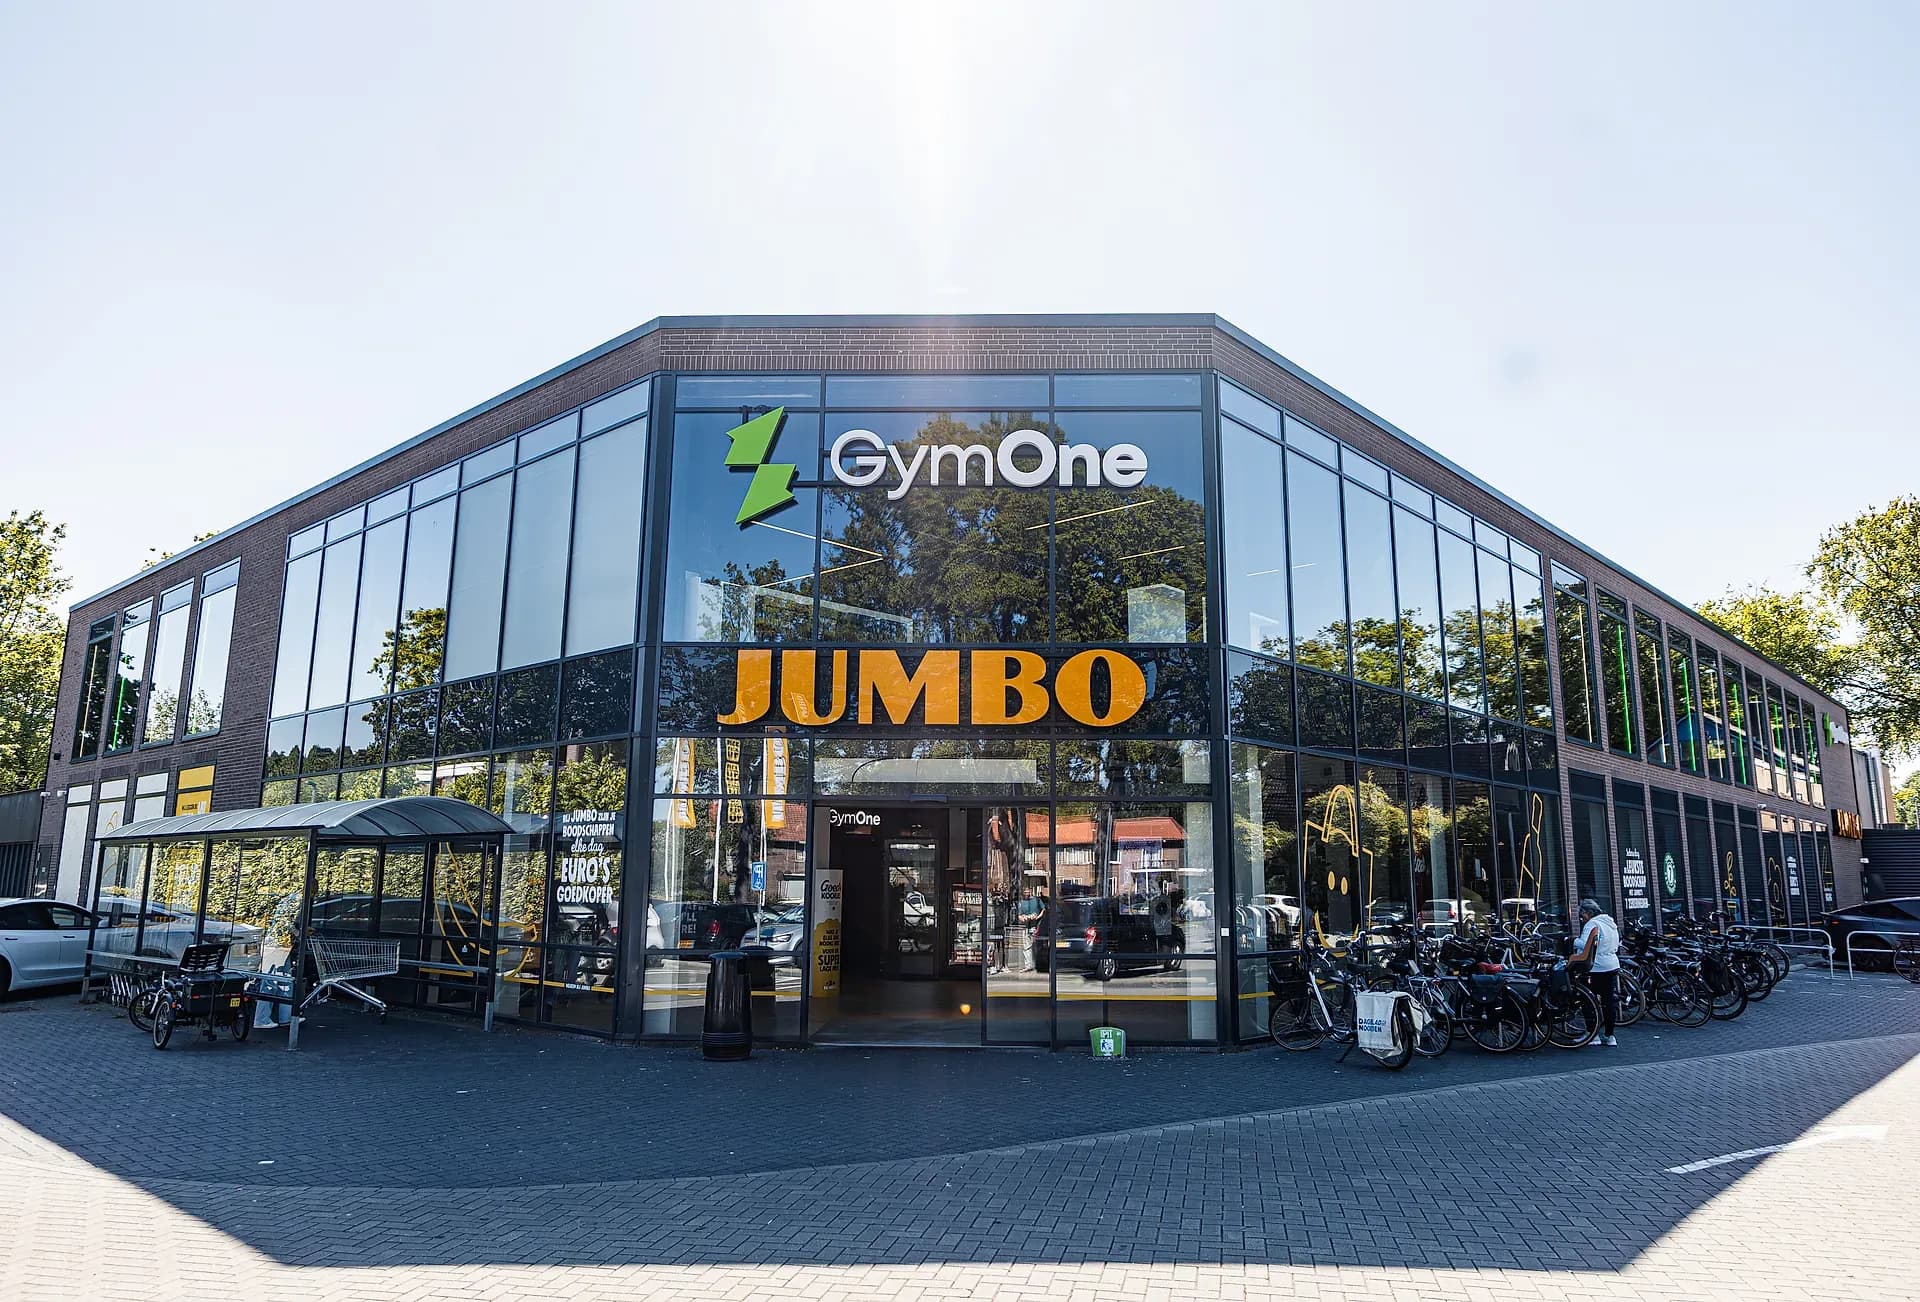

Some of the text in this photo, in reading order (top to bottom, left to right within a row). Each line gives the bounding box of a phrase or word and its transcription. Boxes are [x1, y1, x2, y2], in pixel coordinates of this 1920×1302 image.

[830, 429, 1148, 500] GymOne
[717, 649, 1147, 727] JUMBO
[571, 809, 597, 822] JUMBO
[830, 809, 880, 826] GymOne
[563, 823, 614, 837] BOODSCHAPPEN
[571, 836, 604, 856] elke dag
[561, 856, 611, 883] EURO'S
[557, 886, 613, 904] GOEDKOPER
